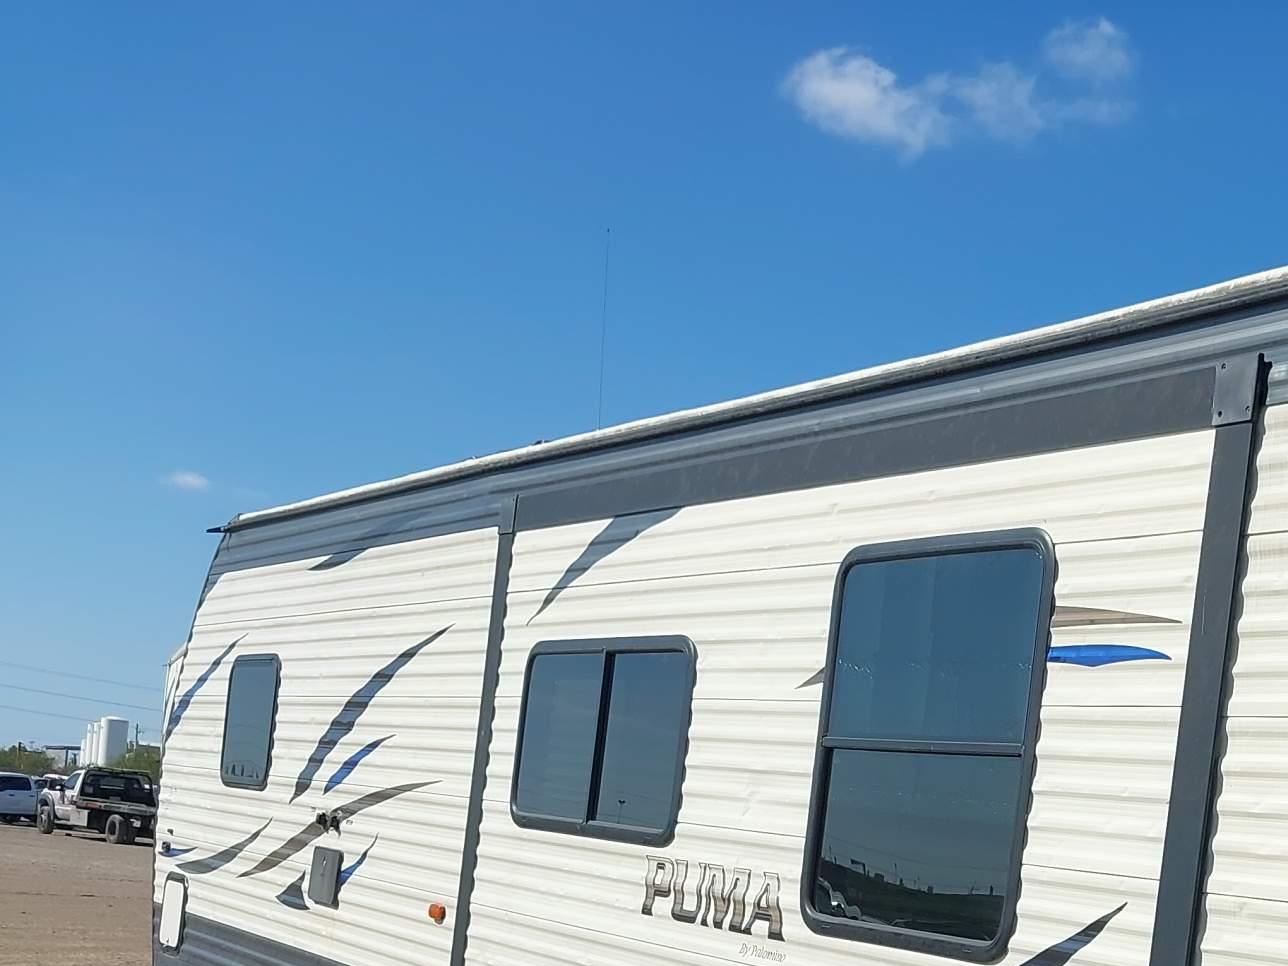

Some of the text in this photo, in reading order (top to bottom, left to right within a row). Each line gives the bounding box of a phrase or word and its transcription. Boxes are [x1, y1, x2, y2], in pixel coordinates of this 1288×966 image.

[641, 855, 785, 942] PUMA
[739, 943, 786, 962] By Palomino
